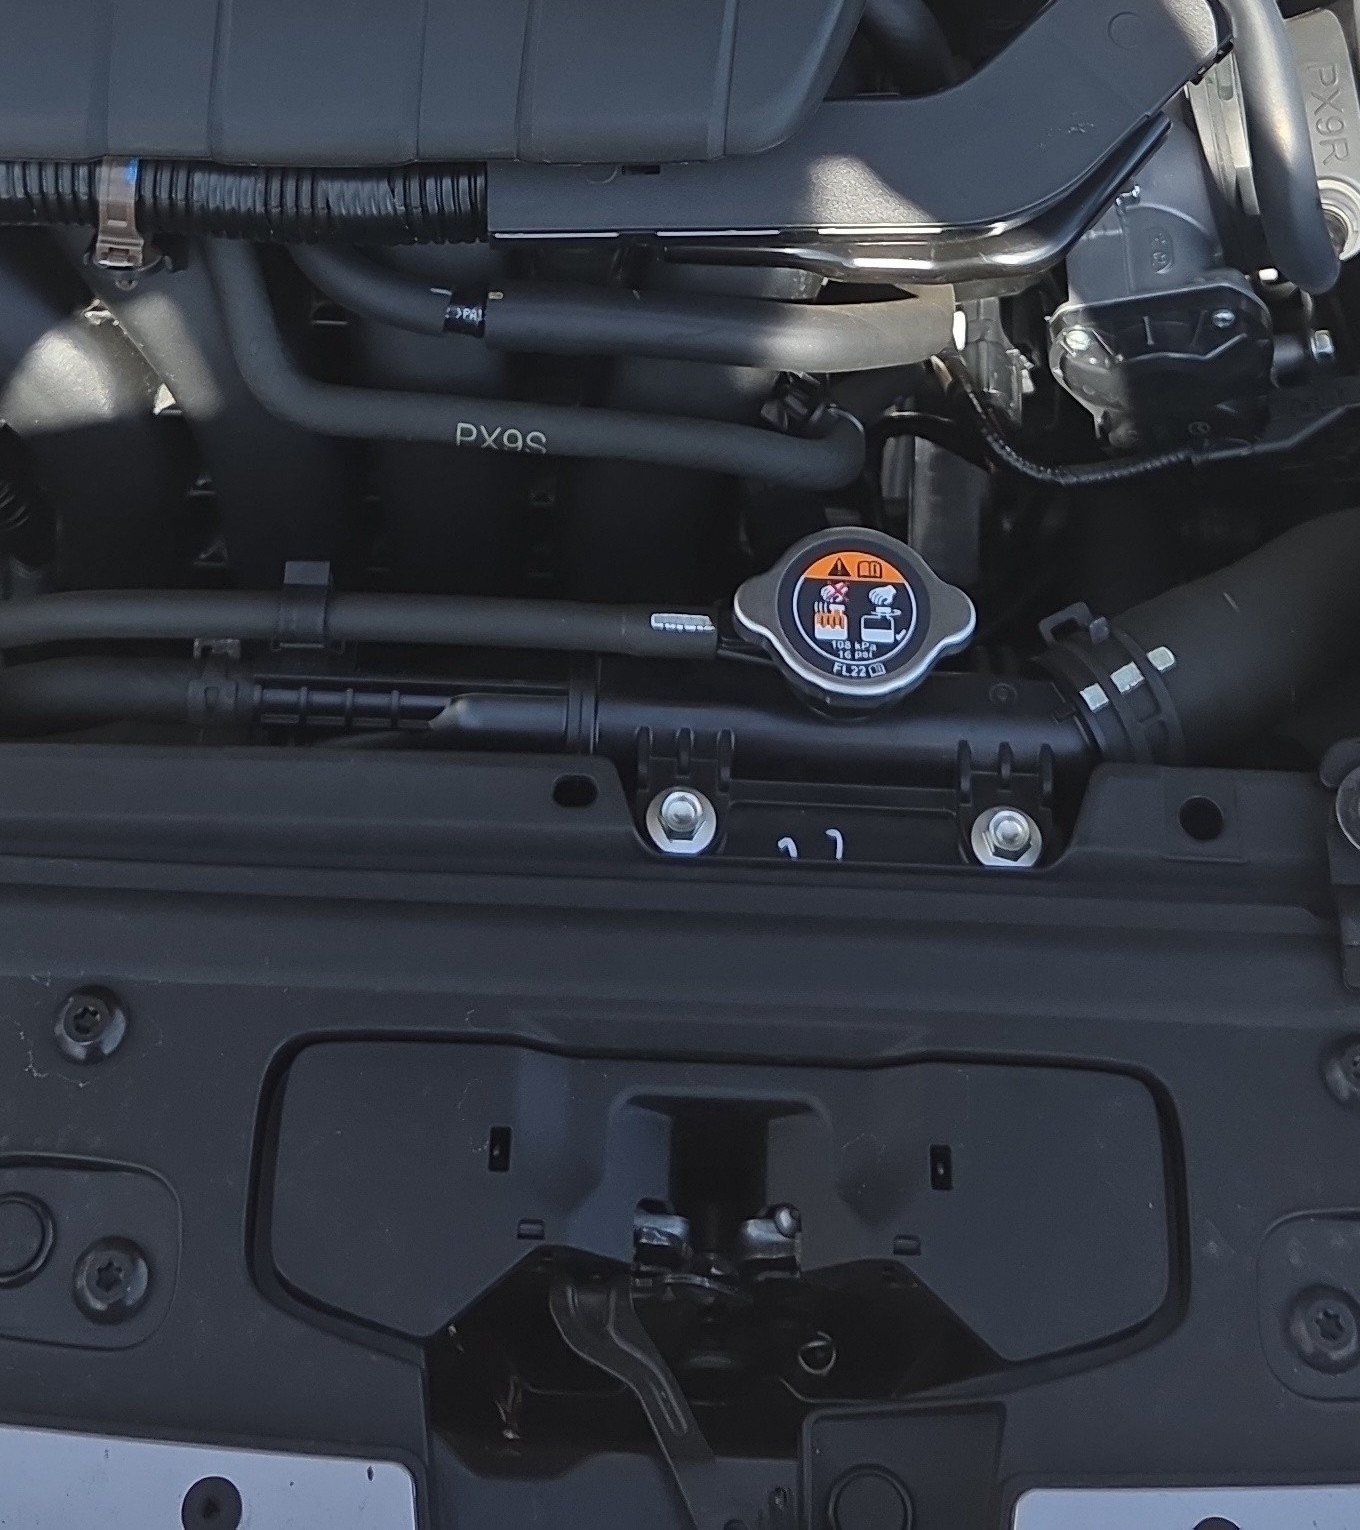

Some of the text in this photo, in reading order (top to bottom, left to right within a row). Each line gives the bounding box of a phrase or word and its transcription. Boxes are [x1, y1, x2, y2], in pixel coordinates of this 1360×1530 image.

[1306, 61, 1349, 166] PX9R
[456, 422, 547, 455] PX9S
[831, 640, 877, 651] 108 kPa
[838, 650, 873, 660] 16 psi
[833, 661, 867, 677] FL22
